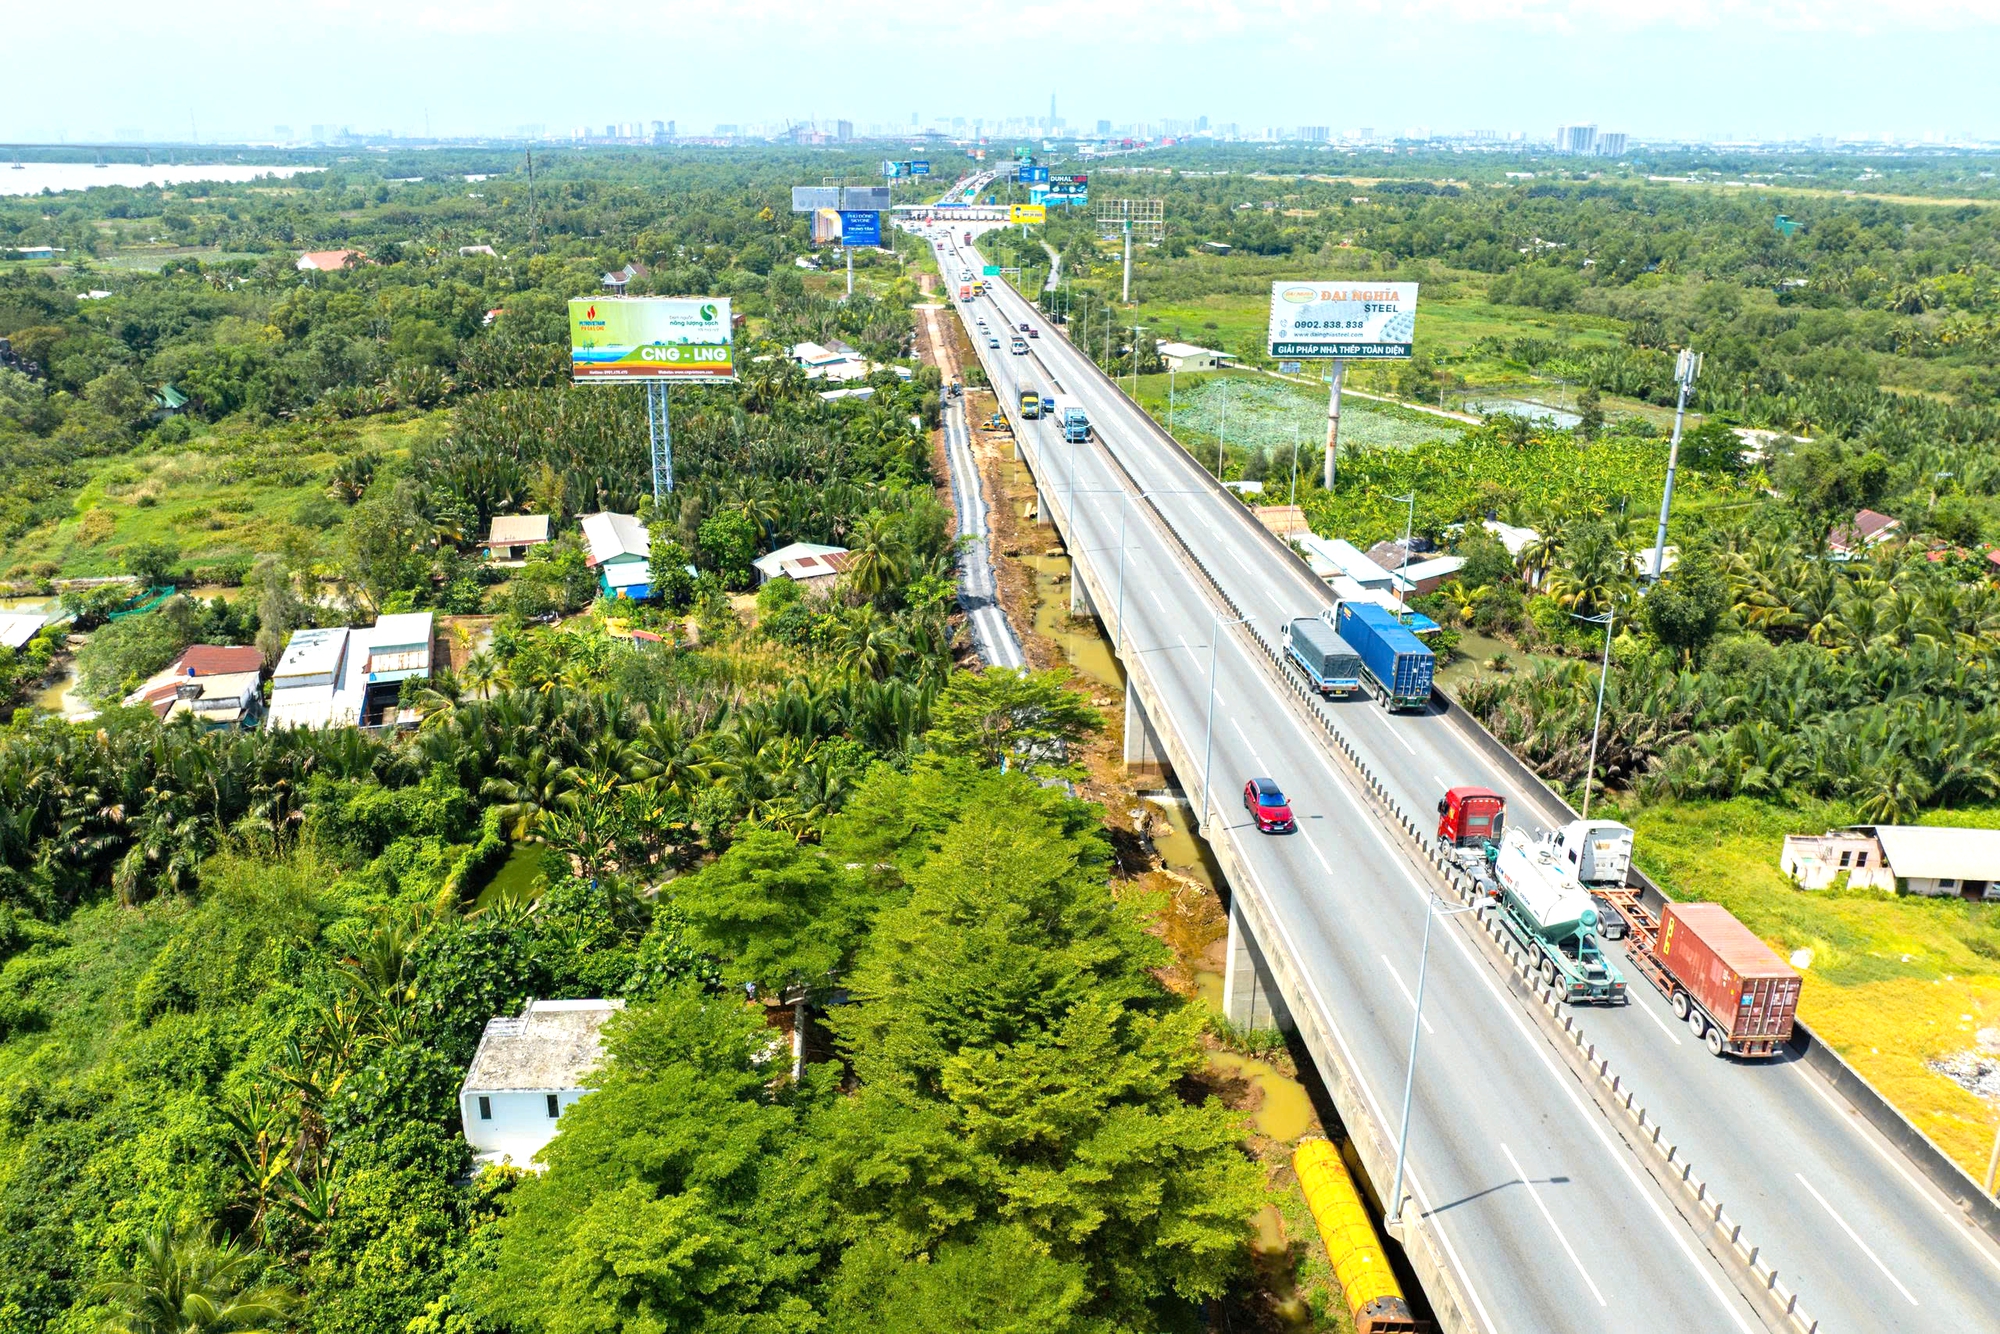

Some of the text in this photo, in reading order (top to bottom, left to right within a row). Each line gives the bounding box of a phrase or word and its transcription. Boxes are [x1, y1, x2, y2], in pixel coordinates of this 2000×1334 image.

[1320, 287, 1400, 304] ĐẠI NGHĨA
[1364, 304, 1399, 313] STEEL
[641, 348, 680, 361] CNG
[693, 348, 727, 361] LNG
[1278, 344, 1404, 356] GIẢI PHÁP NHÀ THÉP TOÀN DIỆN
